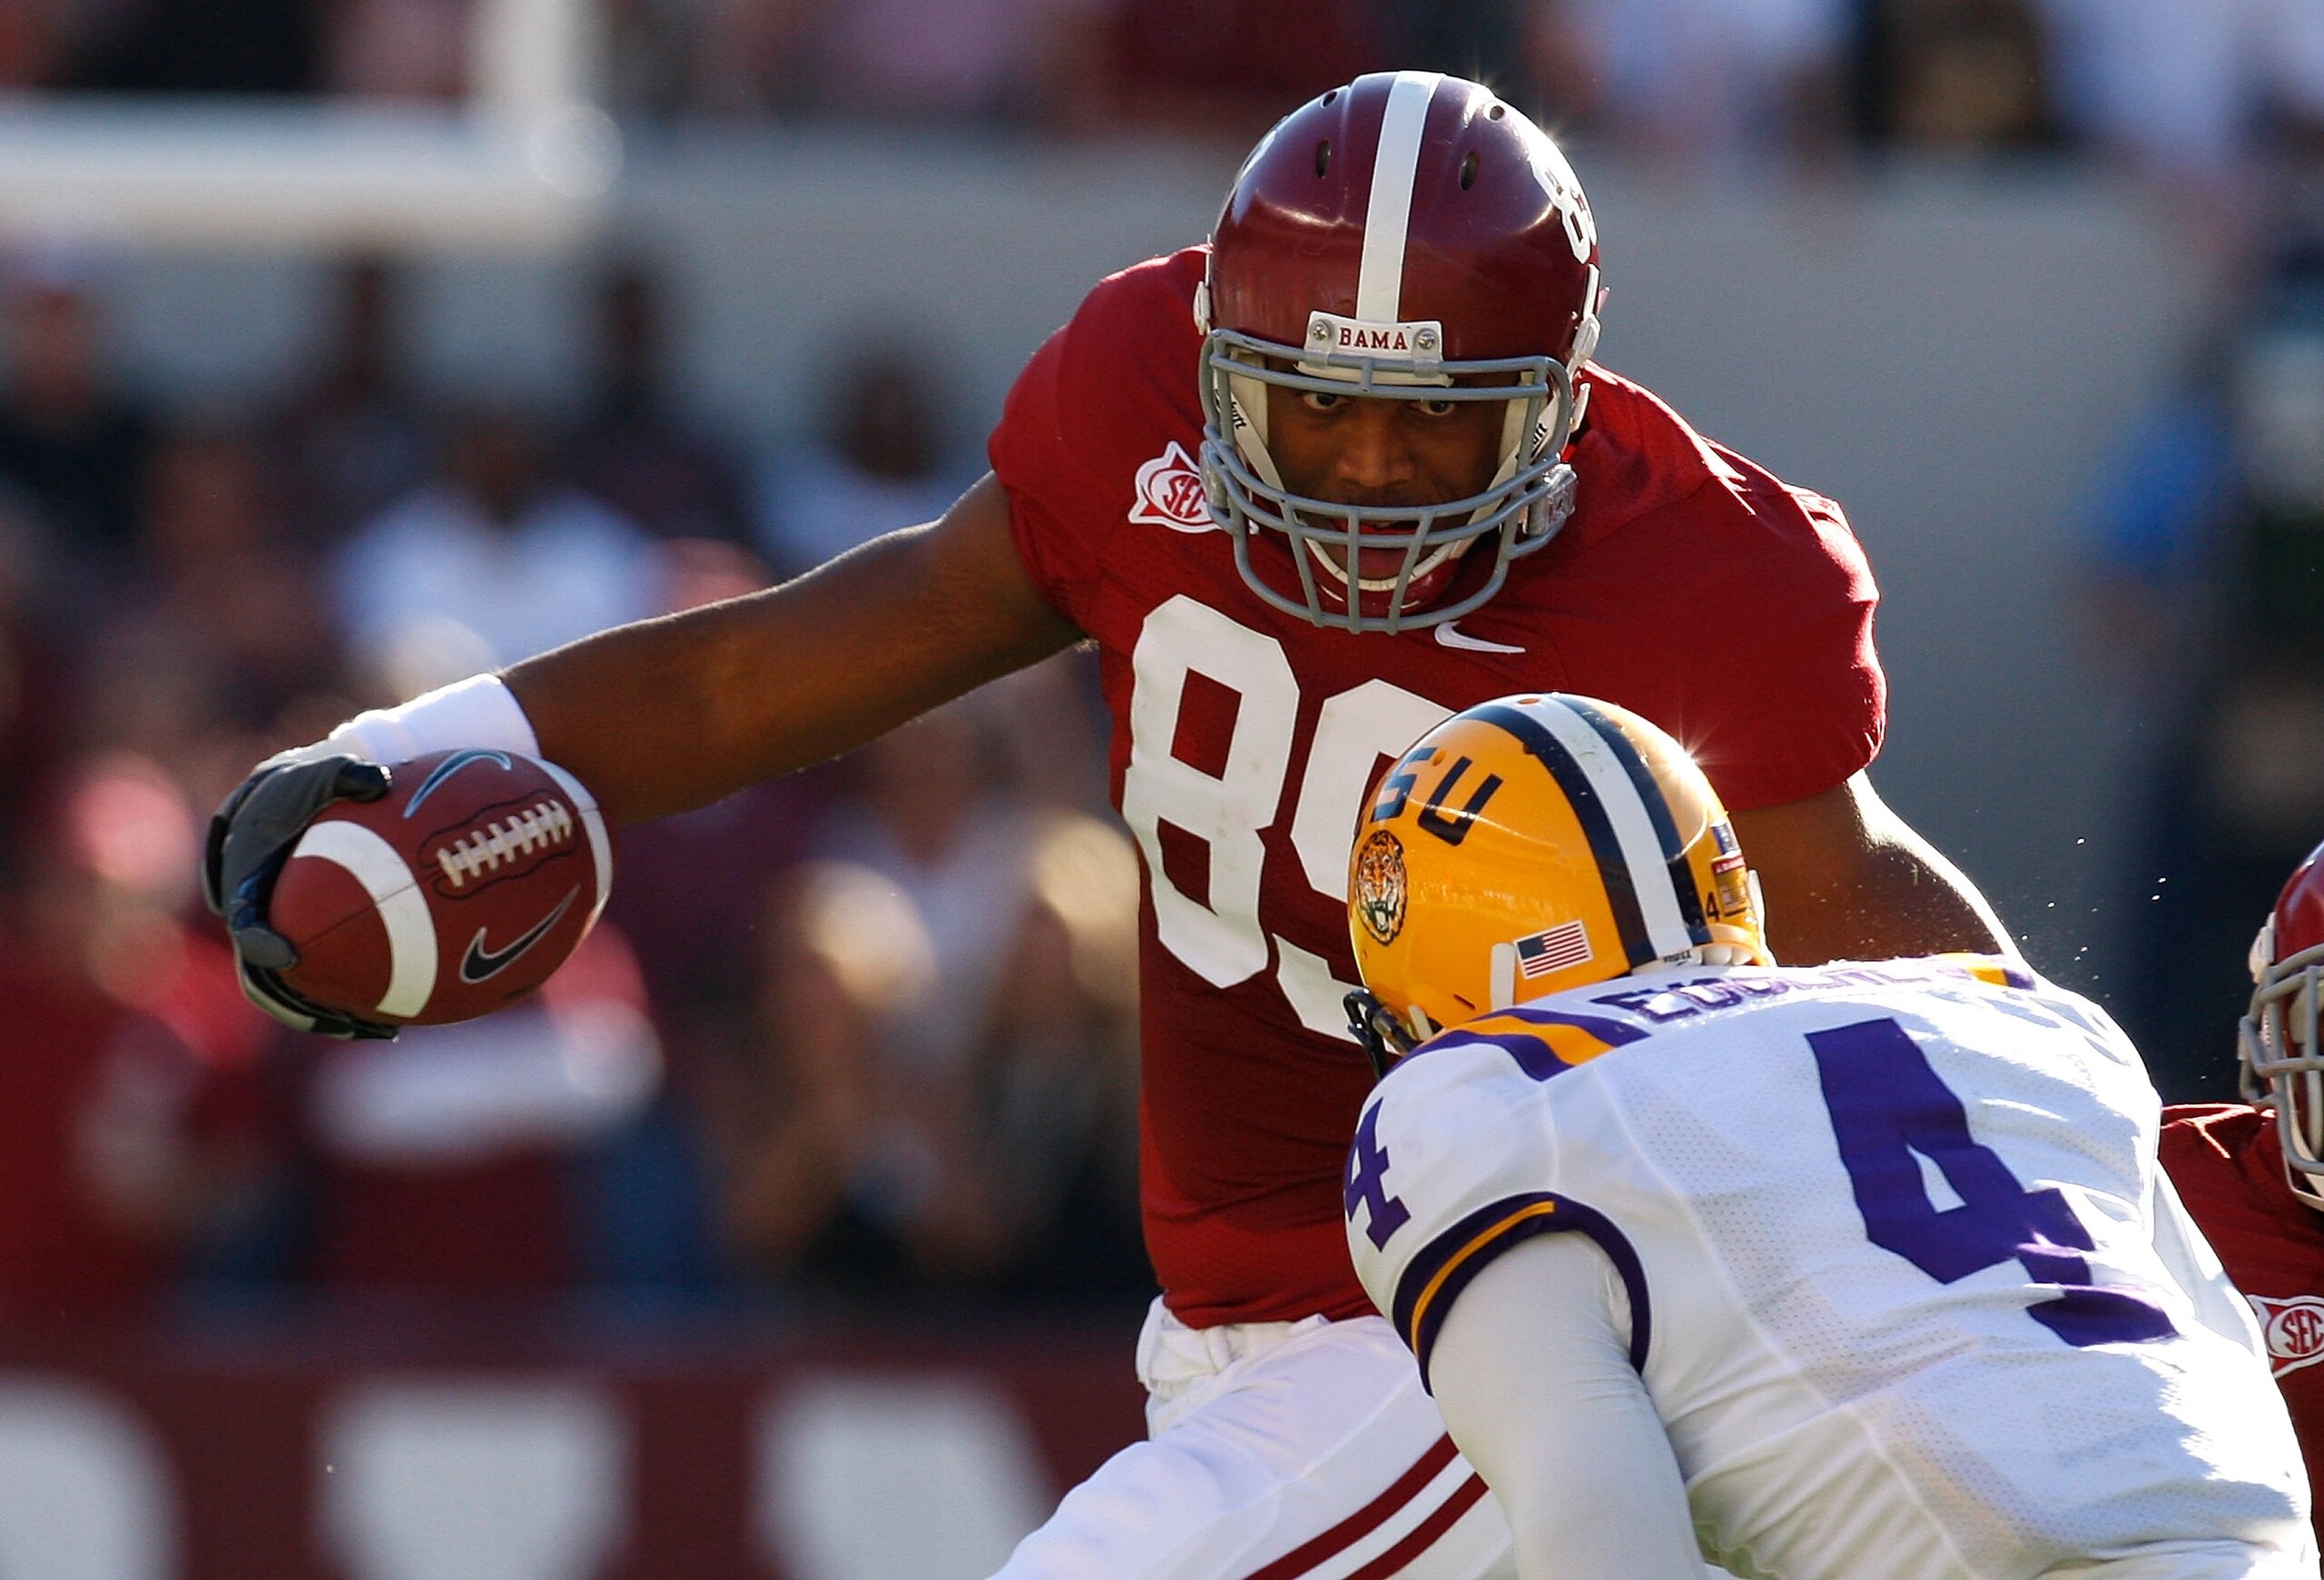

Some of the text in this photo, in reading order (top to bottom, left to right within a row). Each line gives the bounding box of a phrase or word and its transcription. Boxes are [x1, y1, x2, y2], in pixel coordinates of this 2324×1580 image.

[1339, 328, 1408, 350] BAMA
[1369, 746, 1504, 847] SU
[1344, 1096, 1412, 1253] 4
[1805, 1017, 2179, 1347] 4
[2281, 1308, 2324, 1355] SEC
